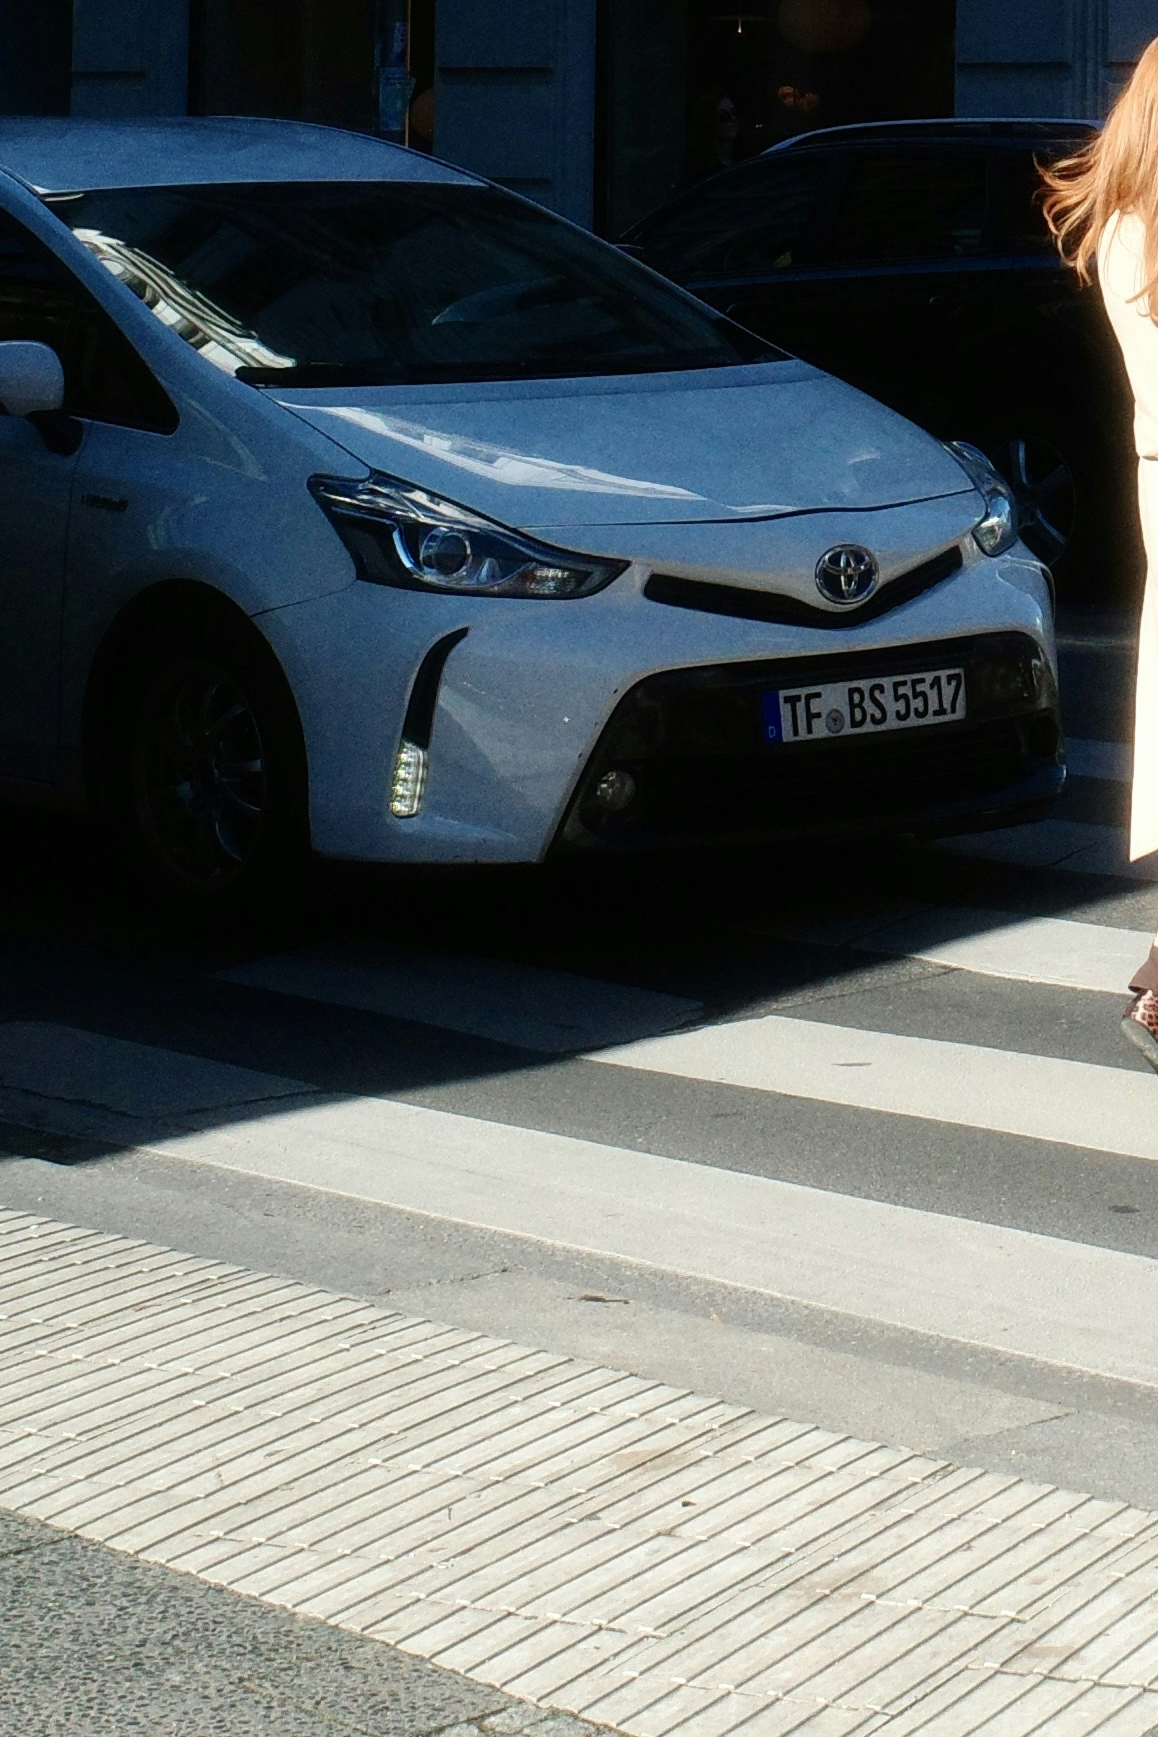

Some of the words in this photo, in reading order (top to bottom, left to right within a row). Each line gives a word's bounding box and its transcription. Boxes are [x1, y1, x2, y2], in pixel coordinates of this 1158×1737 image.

[783, 691, 822, 738] TF
[847, 683, 887, 729] BS
[892, 673, 962, 722] 5517
[768, 725, 776, 739] D
